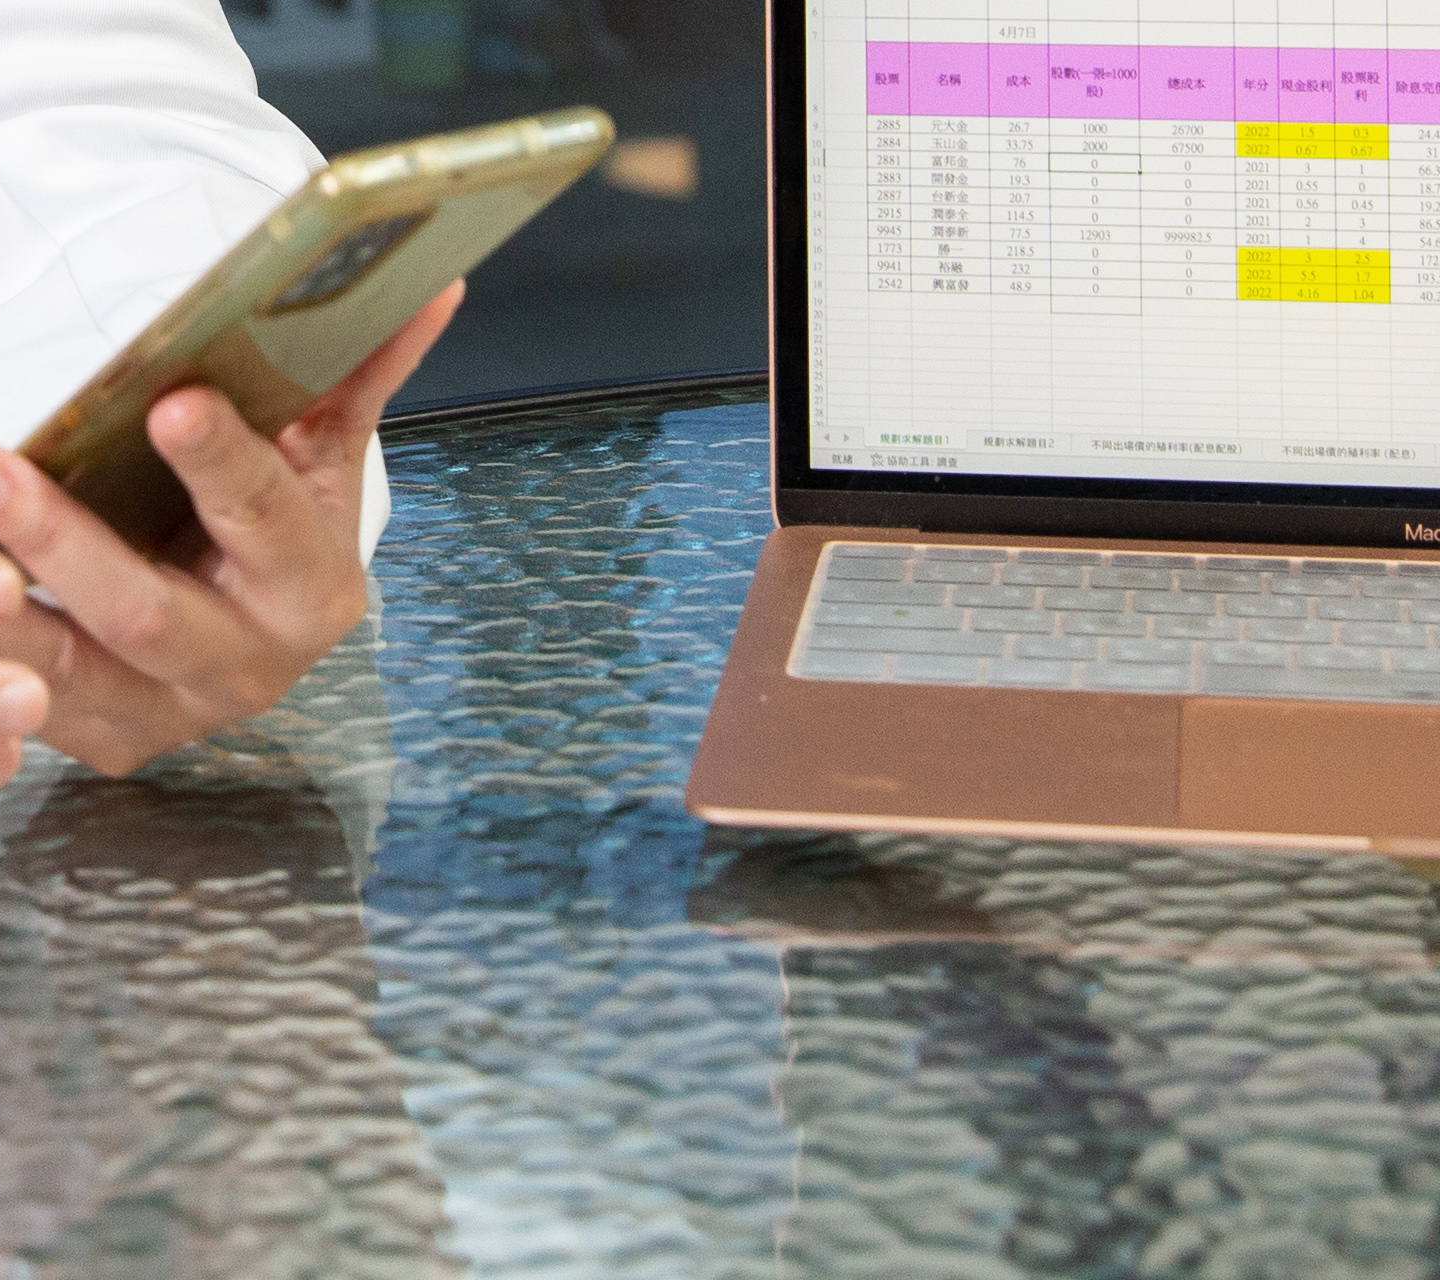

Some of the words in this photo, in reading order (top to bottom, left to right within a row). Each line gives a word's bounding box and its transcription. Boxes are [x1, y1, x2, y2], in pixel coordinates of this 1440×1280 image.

[999, 27, 1036, 39] 4月7日
[1006, 75, 1031, 87] 成本
[876, 119, 902, 132] 2885
[1008, 121, 1030, 133] 26.7
[1083, 122, 1108, 135] 1000
[1171, 124, 1205, 136] 26700
[877, 137, 901, 149] 2884
[1006, 138, 1034, 151] 33.75
[1082, 140, 1108, 153] 2000
[1171, 141, 1205, 154] 67500
[1426, 146, 1438, 159] 31
[877, 154, 900, 167] 2881
[1013, 156, 1027, 169] 76
[1245, 161, 1270, 174] 2021
[877, 172, 902, 184] 2883
[1009, 174, 1031, 186] 19.3
[1245, 179, 1270, 191] 2021
[877, 189, 902, 202] 2887
[1009, 192, 1031, 204] 20.7
[1245, 197, 1270, 209] 2021
[877, 207, 902, 219] 2915
[1007, 209, 1035, 222] 114.5
[1245, 215, 1271, 227] 2021
[876, 224, 902, 237] 9945
[1009, 227, 1031, 240] 77.5
[1080, 229, 1112, 241] 12903
[1245, 233, 1271, 245] 2021
[878, 242, 903, 255] 1773
[1007, 245, 1035, 257] 218.5
[877, 260, 902, 272] 9941
[1011, 263, 1031, 275] 232
[877, 277, 903, 290] 2542
[1009, 280, 1032, 293] 48.9
